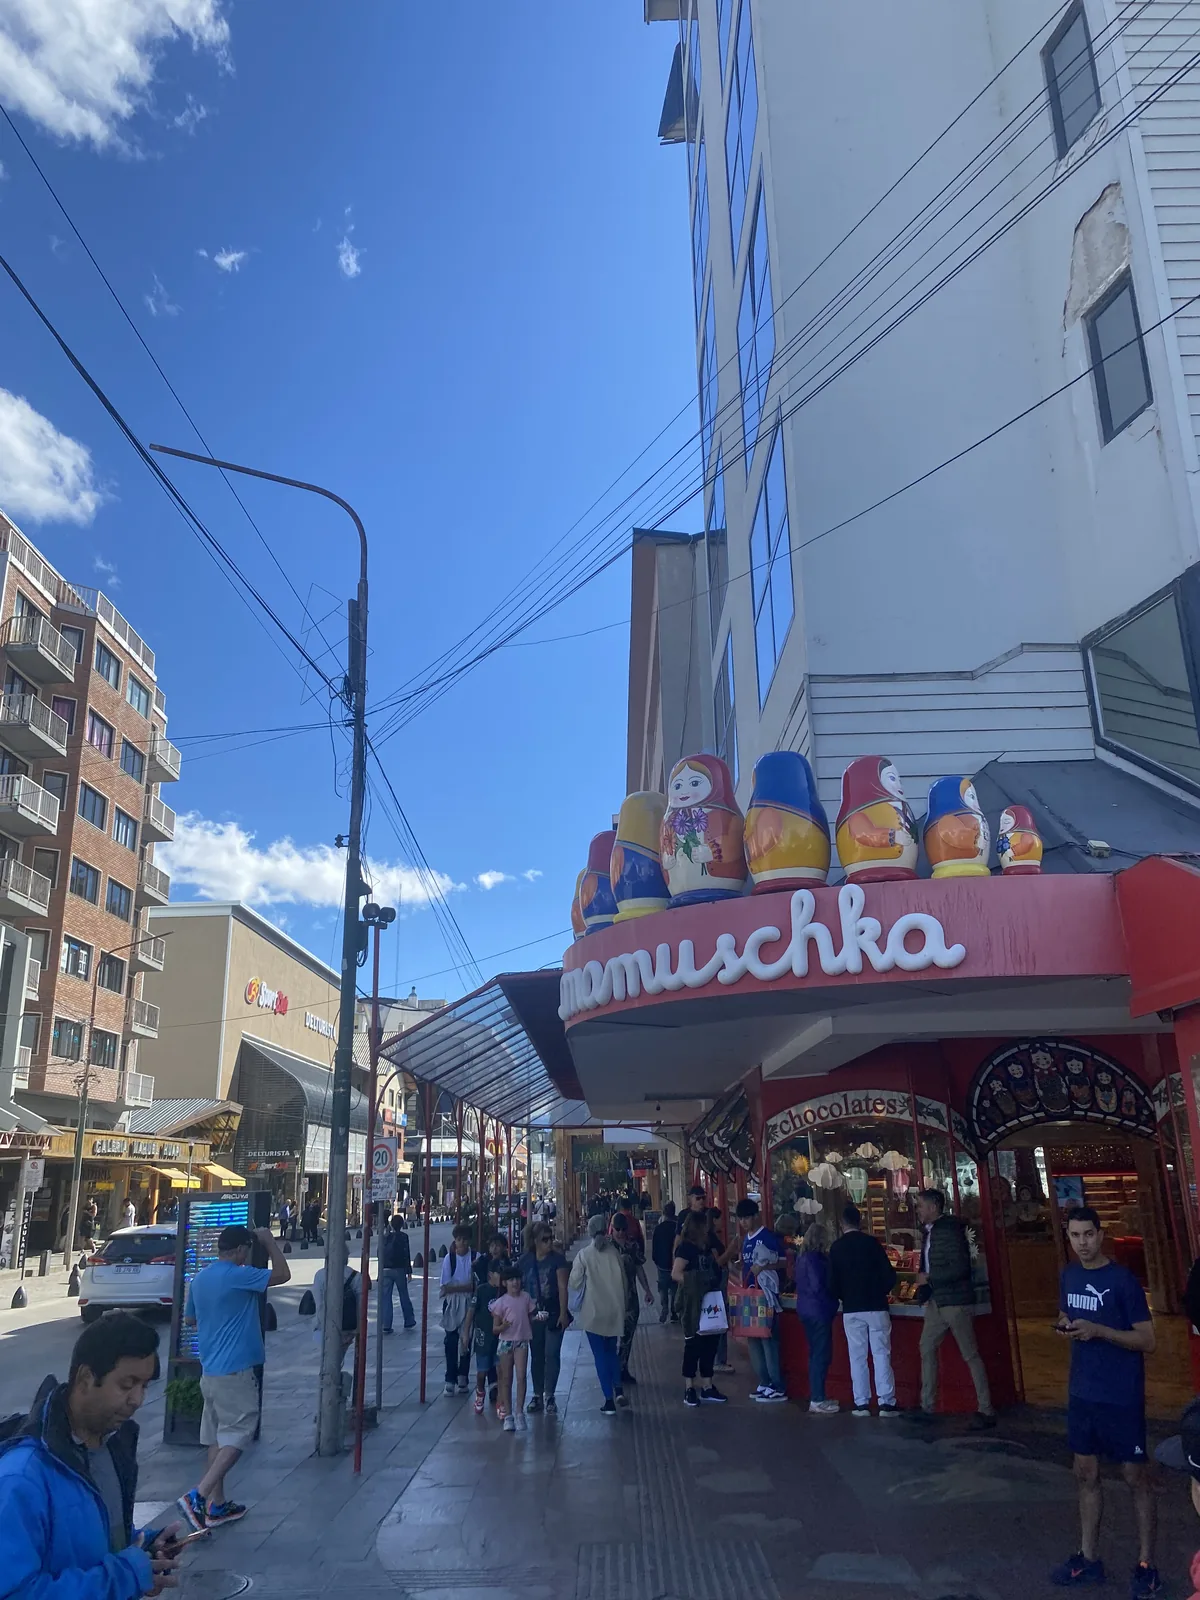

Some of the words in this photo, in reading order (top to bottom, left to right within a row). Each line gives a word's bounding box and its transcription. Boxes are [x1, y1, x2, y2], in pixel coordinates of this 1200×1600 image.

[779, 1093, 898, 1135] chocolates
[374, 1150, 388, 1167] 20
[1067, 1293, 1098, 1311] PUMA
